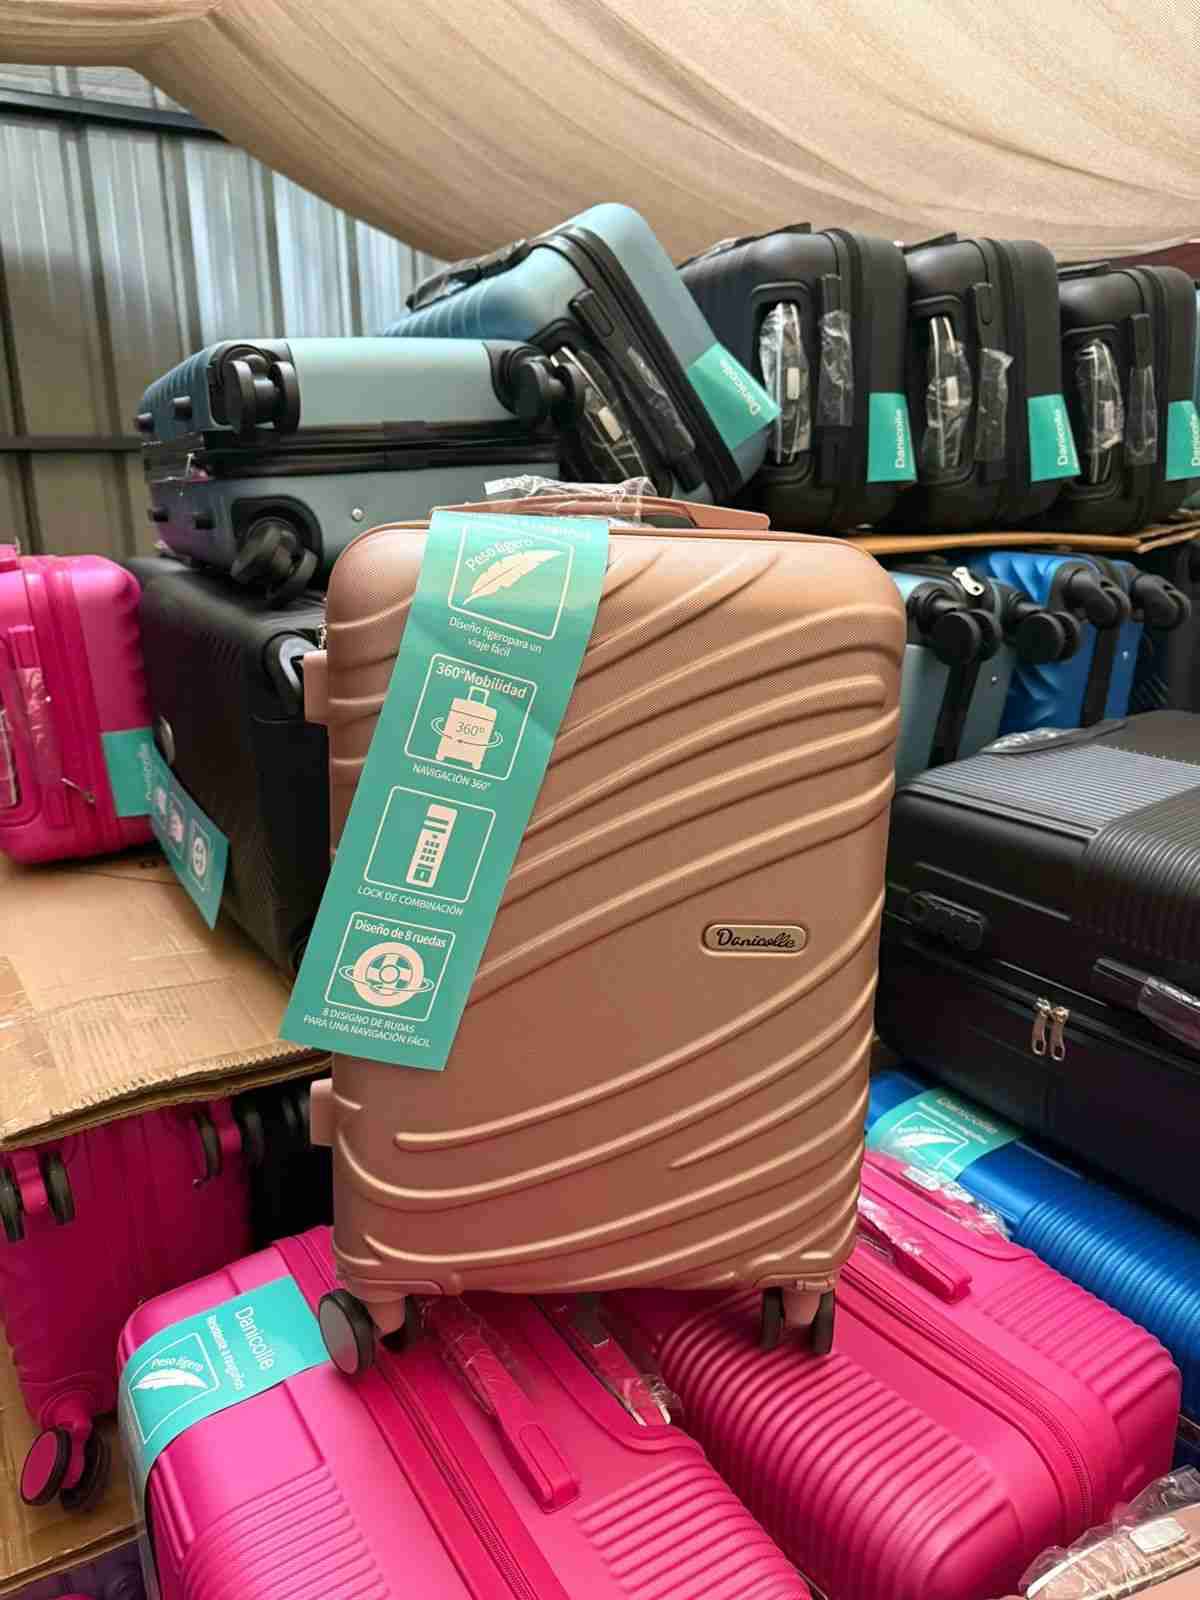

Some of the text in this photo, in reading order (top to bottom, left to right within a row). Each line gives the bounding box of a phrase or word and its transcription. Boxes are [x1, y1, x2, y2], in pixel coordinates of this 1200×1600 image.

[465, 549, 496, 571] Peso
[449, 616, 481, 635] Diseño
[529, 640, 543, 653] un
[467, 637, 512, 657] viaje fácil
[358, 885, 464, 917] LOCK DE COMBINACIÓN
[354, 919, 447, 949] Diseño de 8 ruedas
[716, 928, 796, 948] Danicolle
[303, 1014, 329, 1030] PARA
[328, 1020, 350, 1033] UNA
[370, 1016, 384, 1028] DE
[383, 1019, 416, 1034] RUDAS
[235, 1305, 274, 1371] Danicolle
